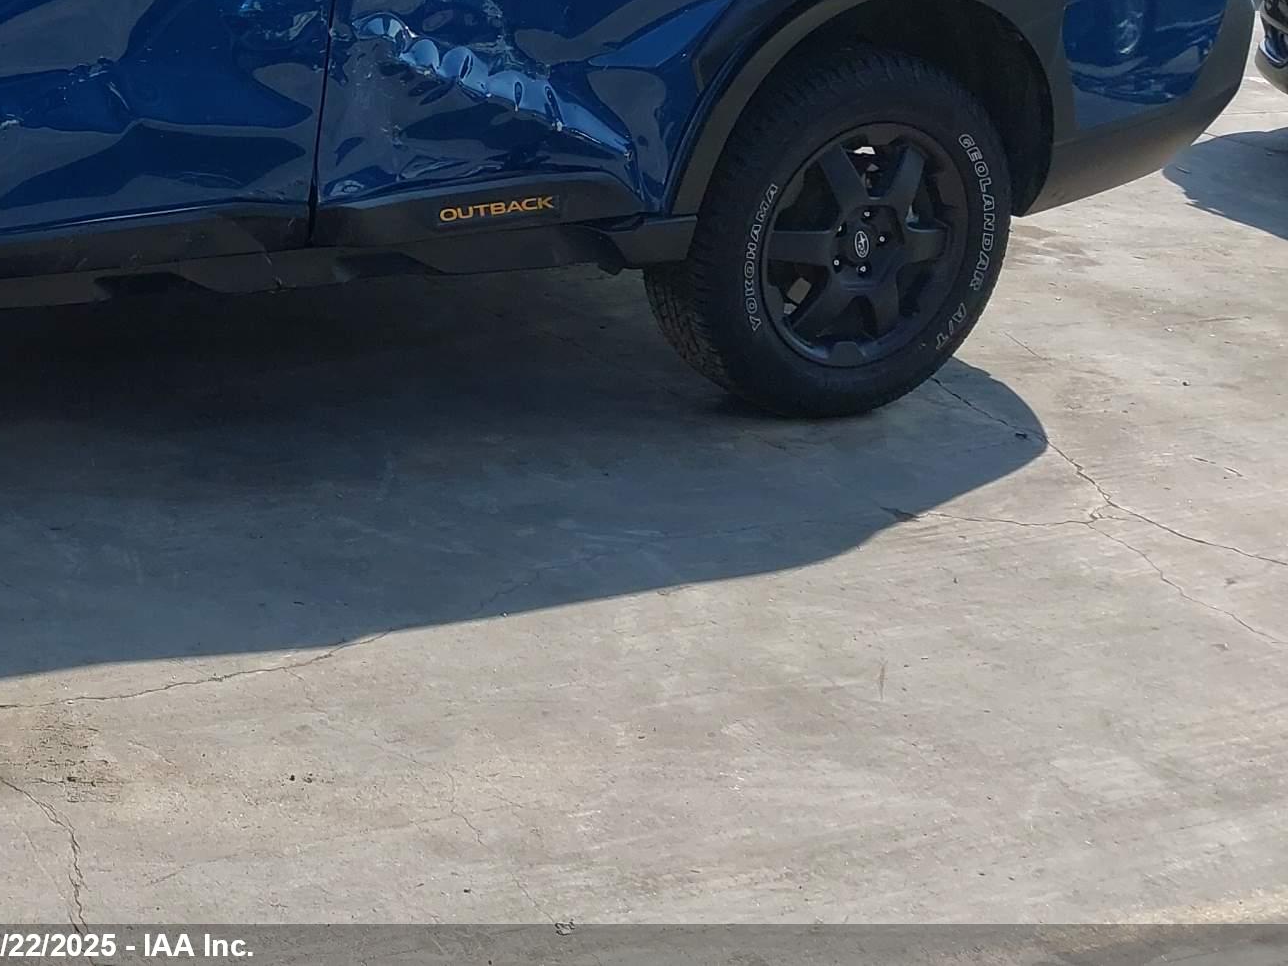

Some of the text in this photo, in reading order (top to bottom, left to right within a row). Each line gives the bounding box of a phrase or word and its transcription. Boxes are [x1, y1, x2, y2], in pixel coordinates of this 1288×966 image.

[439, 196, 554, 222] OUTBACK
[744, 183, 779, 332] YOKOHAMA
[936, 133, 995, 351] GEOLANDAR A/T
